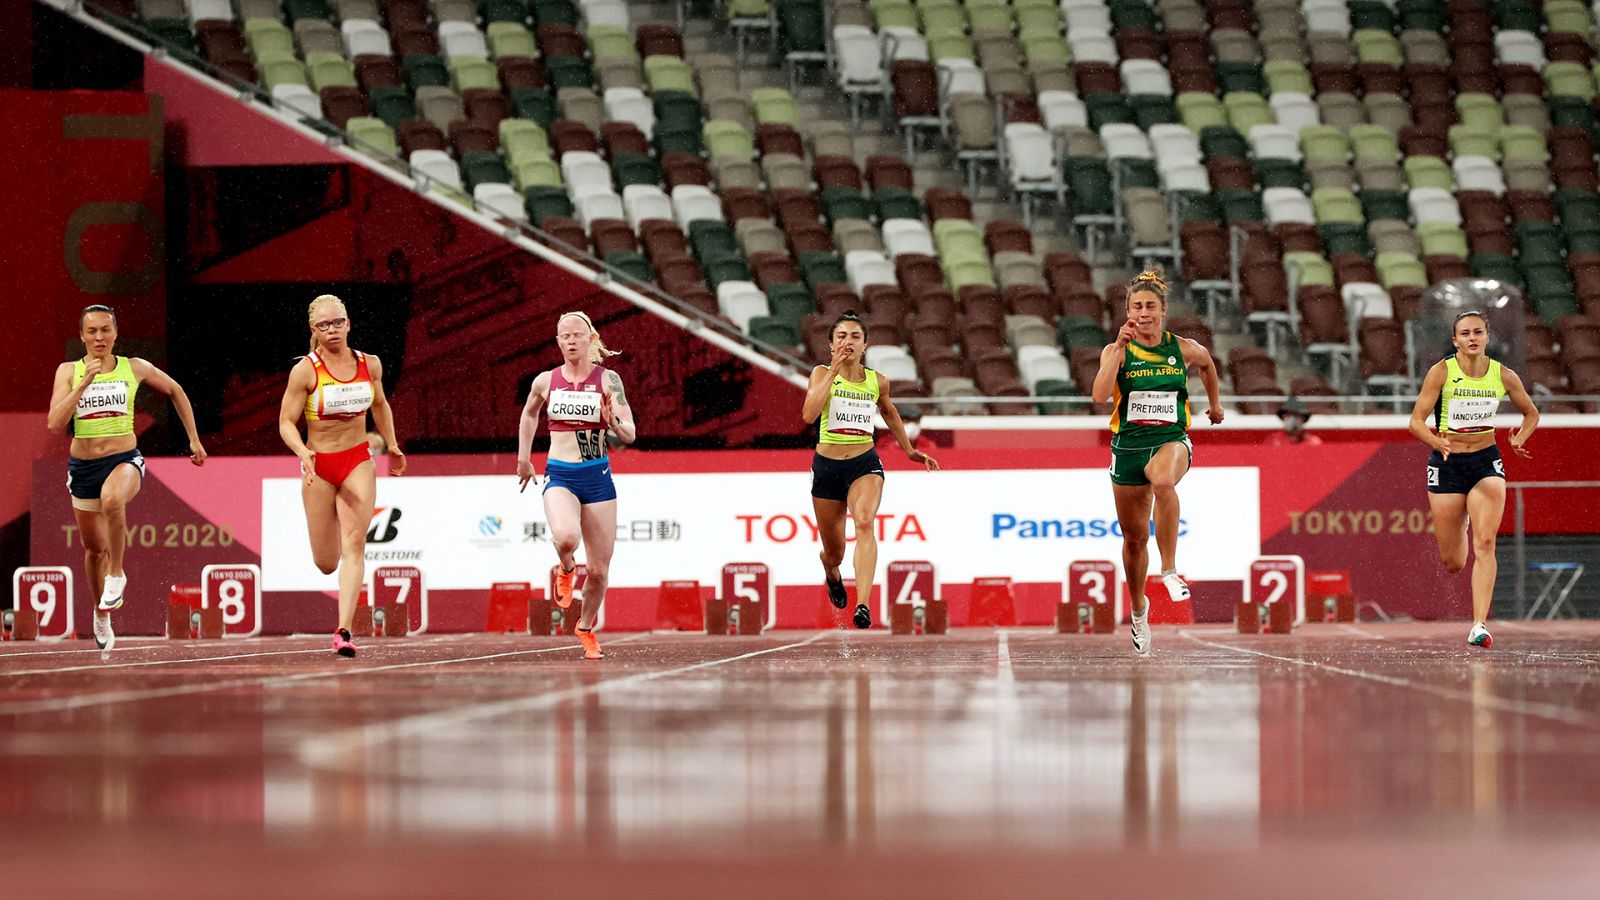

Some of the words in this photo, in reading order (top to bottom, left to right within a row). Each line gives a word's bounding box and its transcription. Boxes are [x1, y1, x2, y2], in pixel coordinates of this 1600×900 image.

[1126, 370, 1153, 378] SOUTH
[1156, 368, 1184, 376] AFRICA
[78, 394, 126, 408] CHEBANU
[552, 403, 596, 415] CROSBY
[1131, 402, 1174, 414] PRETORIUS
[836, 412, 870, 423] VALIYEVA
[1288, 511, 1383, 534] TOKYO
[61, 524, 156, 547] TYO
[164, 524, 233, 547] 2020
[22, 574, 45, 582] TOKYO
[895, 571, 926, 606] 4
[1079, 571, 1106, 604] 3
[1259, 570, 1288, 606] 2
[383, 577, 412, 603] 7
[732, 573, 760, 609] 5
[30, 582, 56, 626] 9
[219, 580, 245, 624] 8
